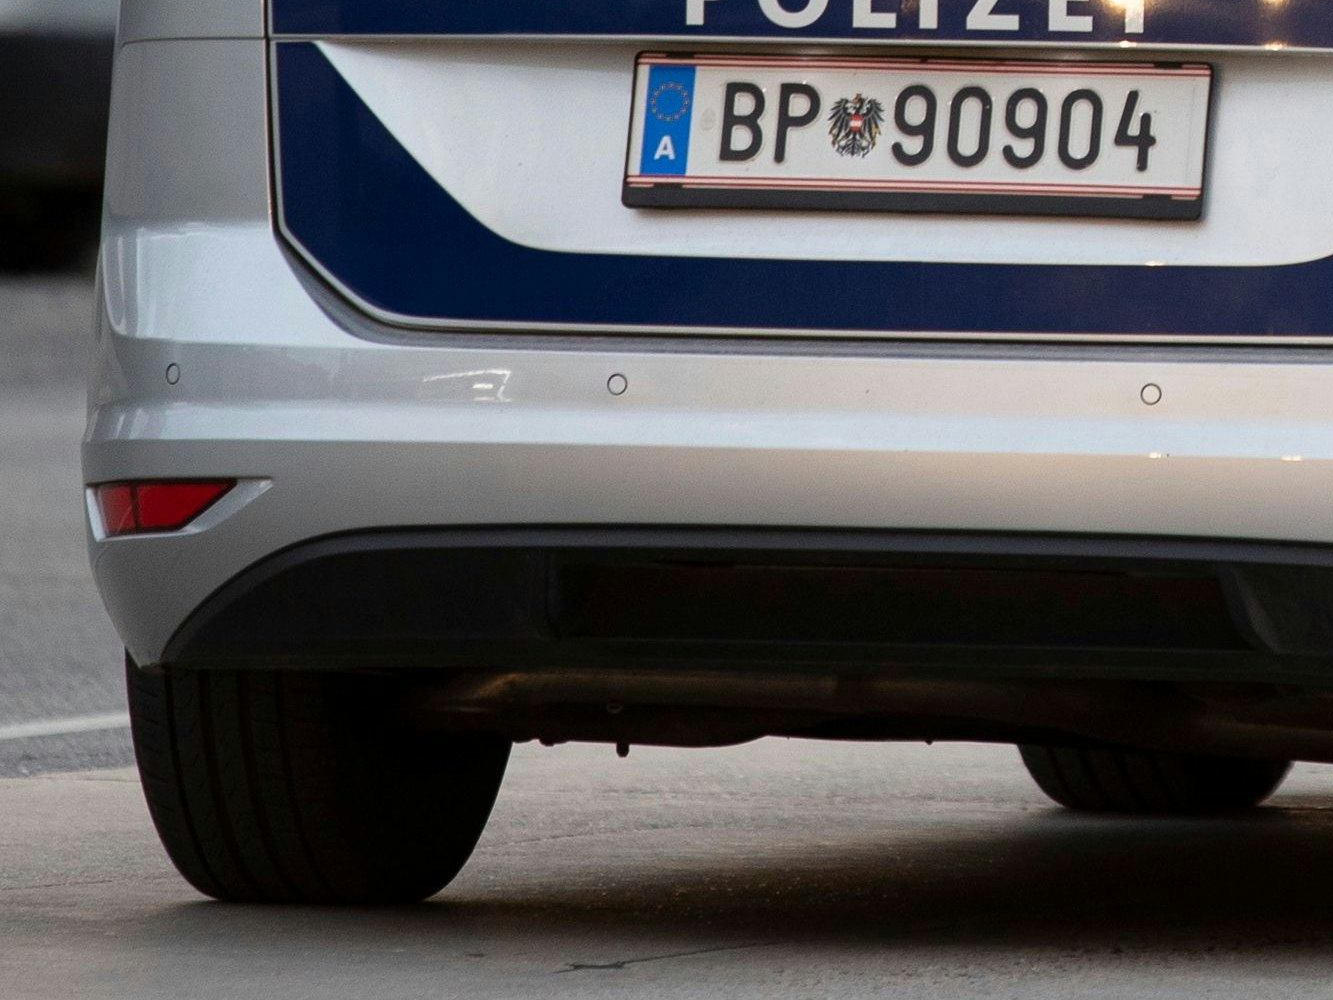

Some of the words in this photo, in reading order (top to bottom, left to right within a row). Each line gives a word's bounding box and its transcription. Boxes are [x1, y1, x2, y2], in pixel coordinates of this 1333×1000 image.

[653, 135, 676, 160] A
[719, 81, 821, 165] BP
[891, 84, 1157, 172] 90904
